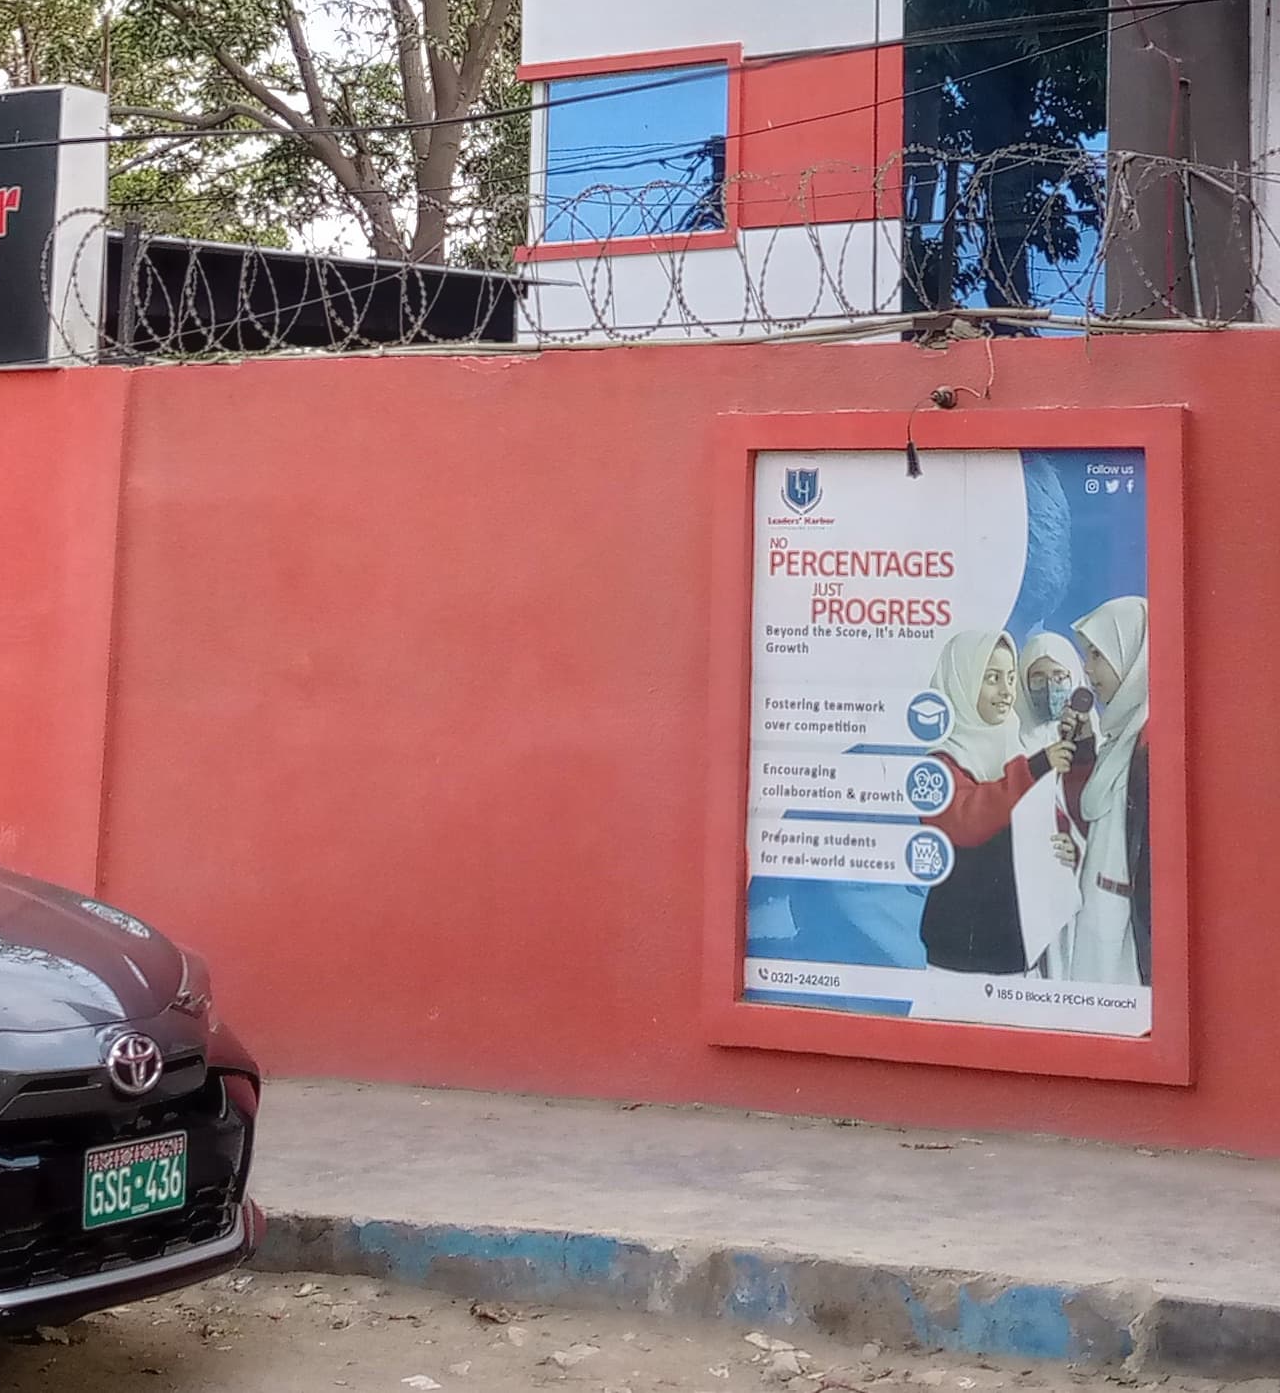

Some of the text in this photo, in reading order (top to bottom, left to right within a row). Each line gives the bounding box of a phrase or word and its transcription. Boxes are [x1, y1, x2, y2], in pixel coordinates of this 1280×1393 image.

[1121, 465, 1134, 475] us
[804, 517, 835, 526] Harbor
[770, 537, 788, 550] NO
[769, 550, 955, 578] PERCENTAGES
[812, 582, 844, 597] JUST
[811, 598, 952, 626] PROGRESS
[766, 625, 934, 640] Beyond the Score, It's About
[766, 642, 809, 654] Growth
[765, 697, 885, 713] Fostering teamwork
[764, 720, 866, 735] over competition
[762, 763, 837, 779] Encouraging
[762, 786, 904, 803] collaboration & growth
[761, 830, 877, 848] Preparing students
[760, 851, 896, 870] for real-world success
[770, 972, 840, 988] 0321-2424216
[997, 989, 1137, 1010] 185 D Block 2 PECHS Karachi
